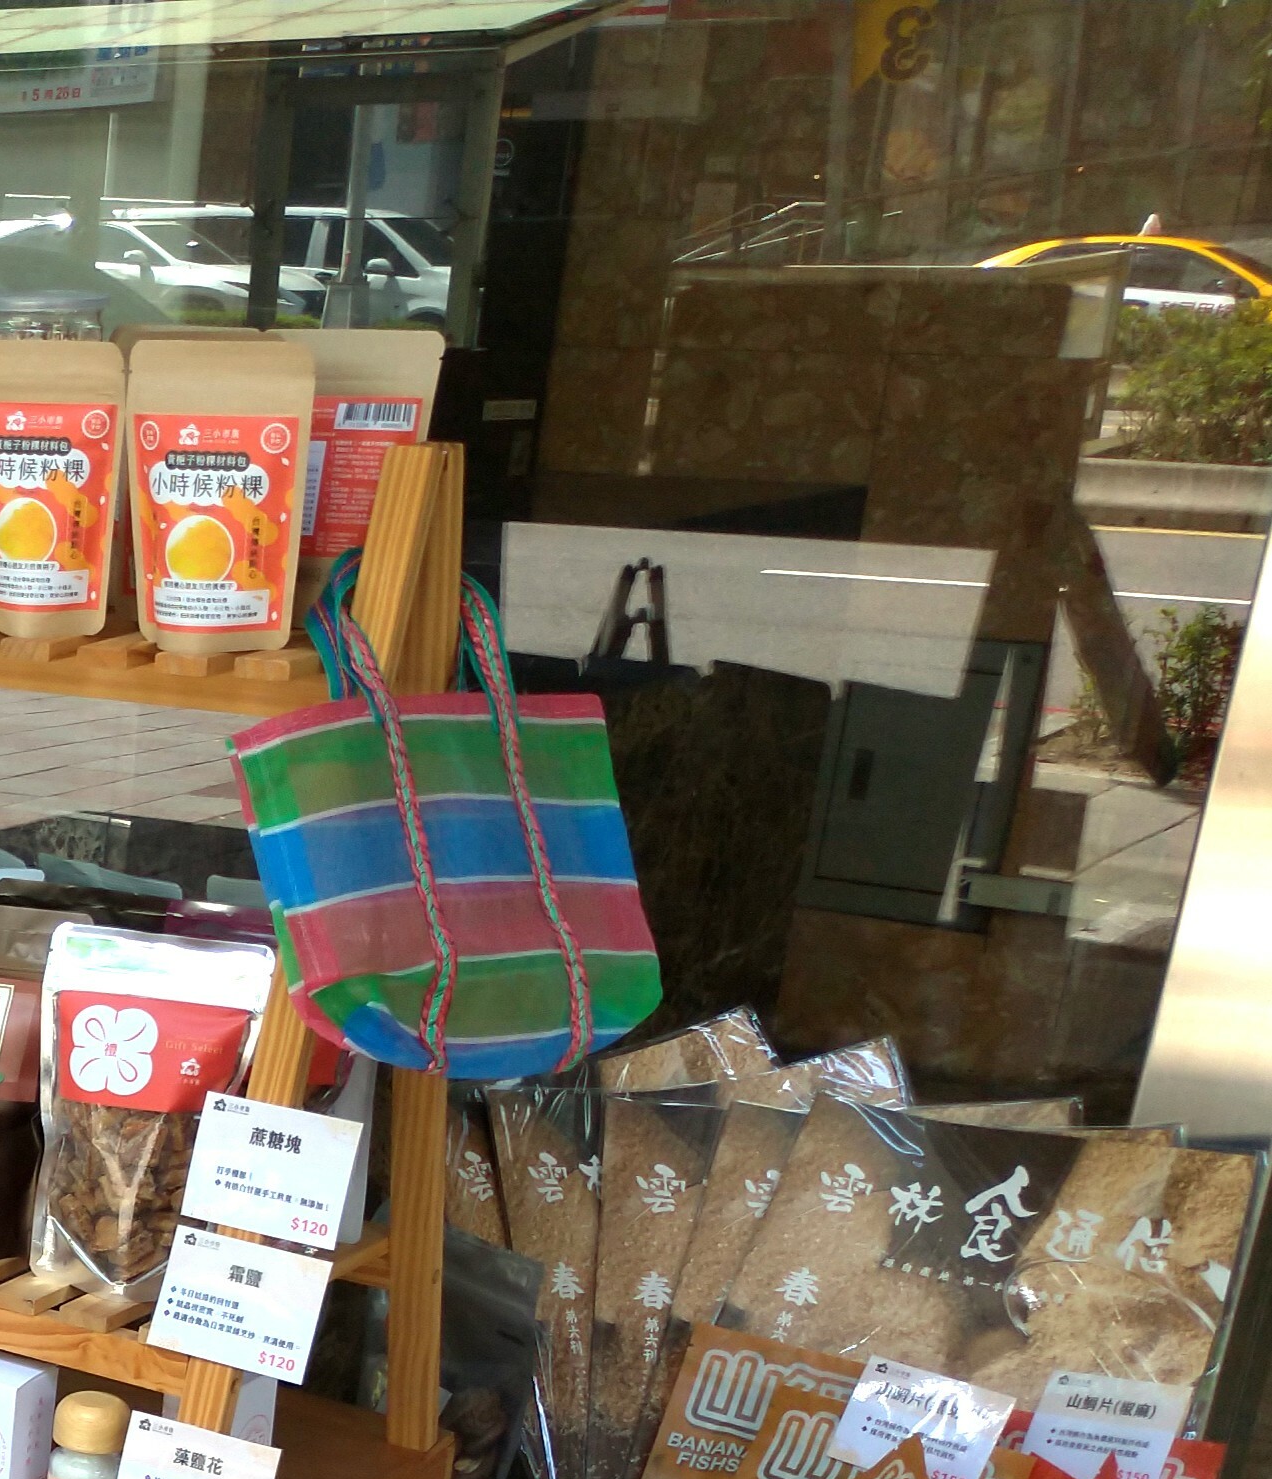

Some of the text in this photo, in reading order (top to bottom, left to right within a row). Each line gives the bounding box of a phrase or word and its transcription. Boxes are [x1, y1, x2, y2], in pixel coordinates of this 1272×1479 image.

[152, 471, 264, 499] 小時候粉粿
[248, 1126, 302, 1155] 蔗糖塊
[290, 1216, 329, 1238] $120
[227, 1264, 264, 1288] 霜鹽
[551, 1262, 584, 1300] 春
[633, 1271, 673, 1310] 春
[773, 1266, 820, 1306] 春
[258, 1350, 296, 1373] $120
[173, 1447, 224, 1476] 藻鹽花
